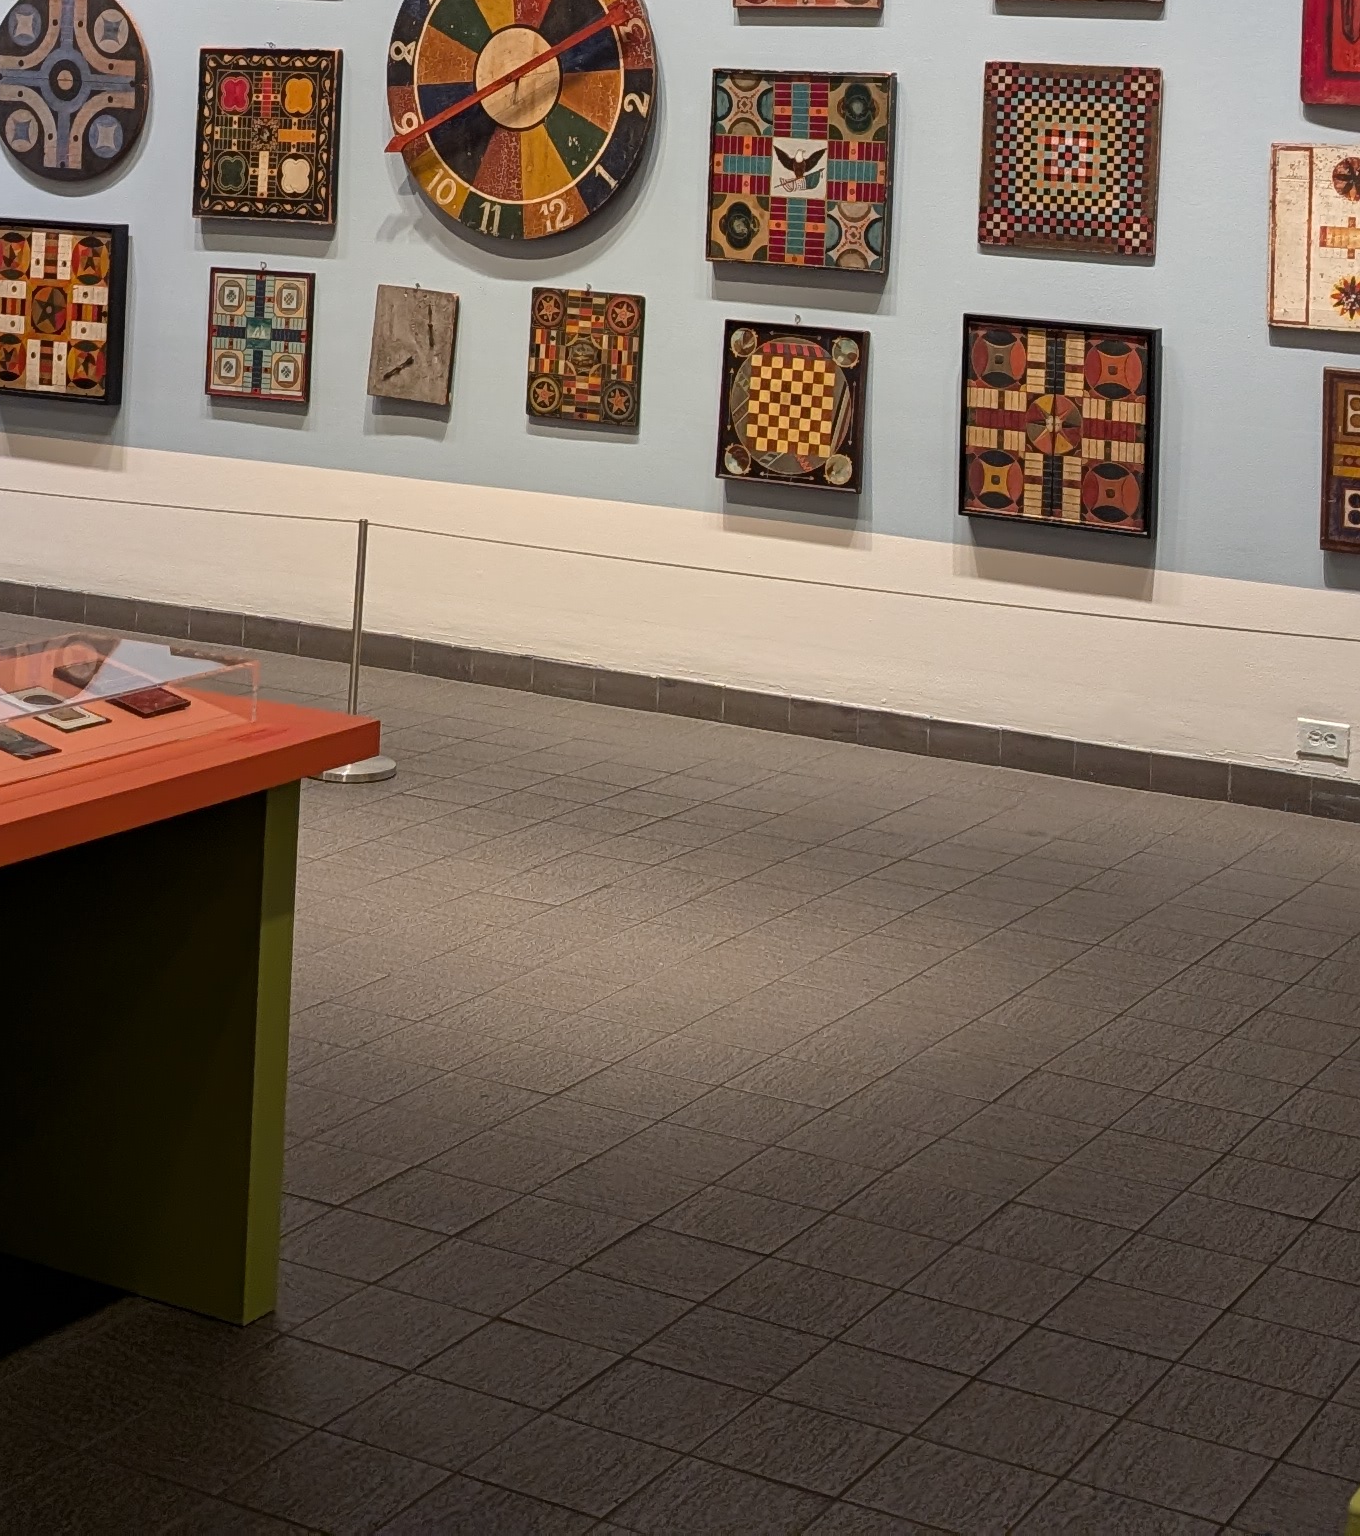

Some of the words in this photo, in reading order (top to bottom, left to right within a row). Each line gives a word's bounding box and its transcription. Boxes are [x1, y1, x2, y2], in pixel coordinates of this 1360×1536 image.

[621, 18, 647, 43] 3
[390, 40, 416, 63] 8
[624, 92, 650, 118] 2
[426, 168, 457, 205] 10
[594, 166, 619, 189] 1
[478, 201, 501, 236] 11
[539, 200, 574, 233] 12
